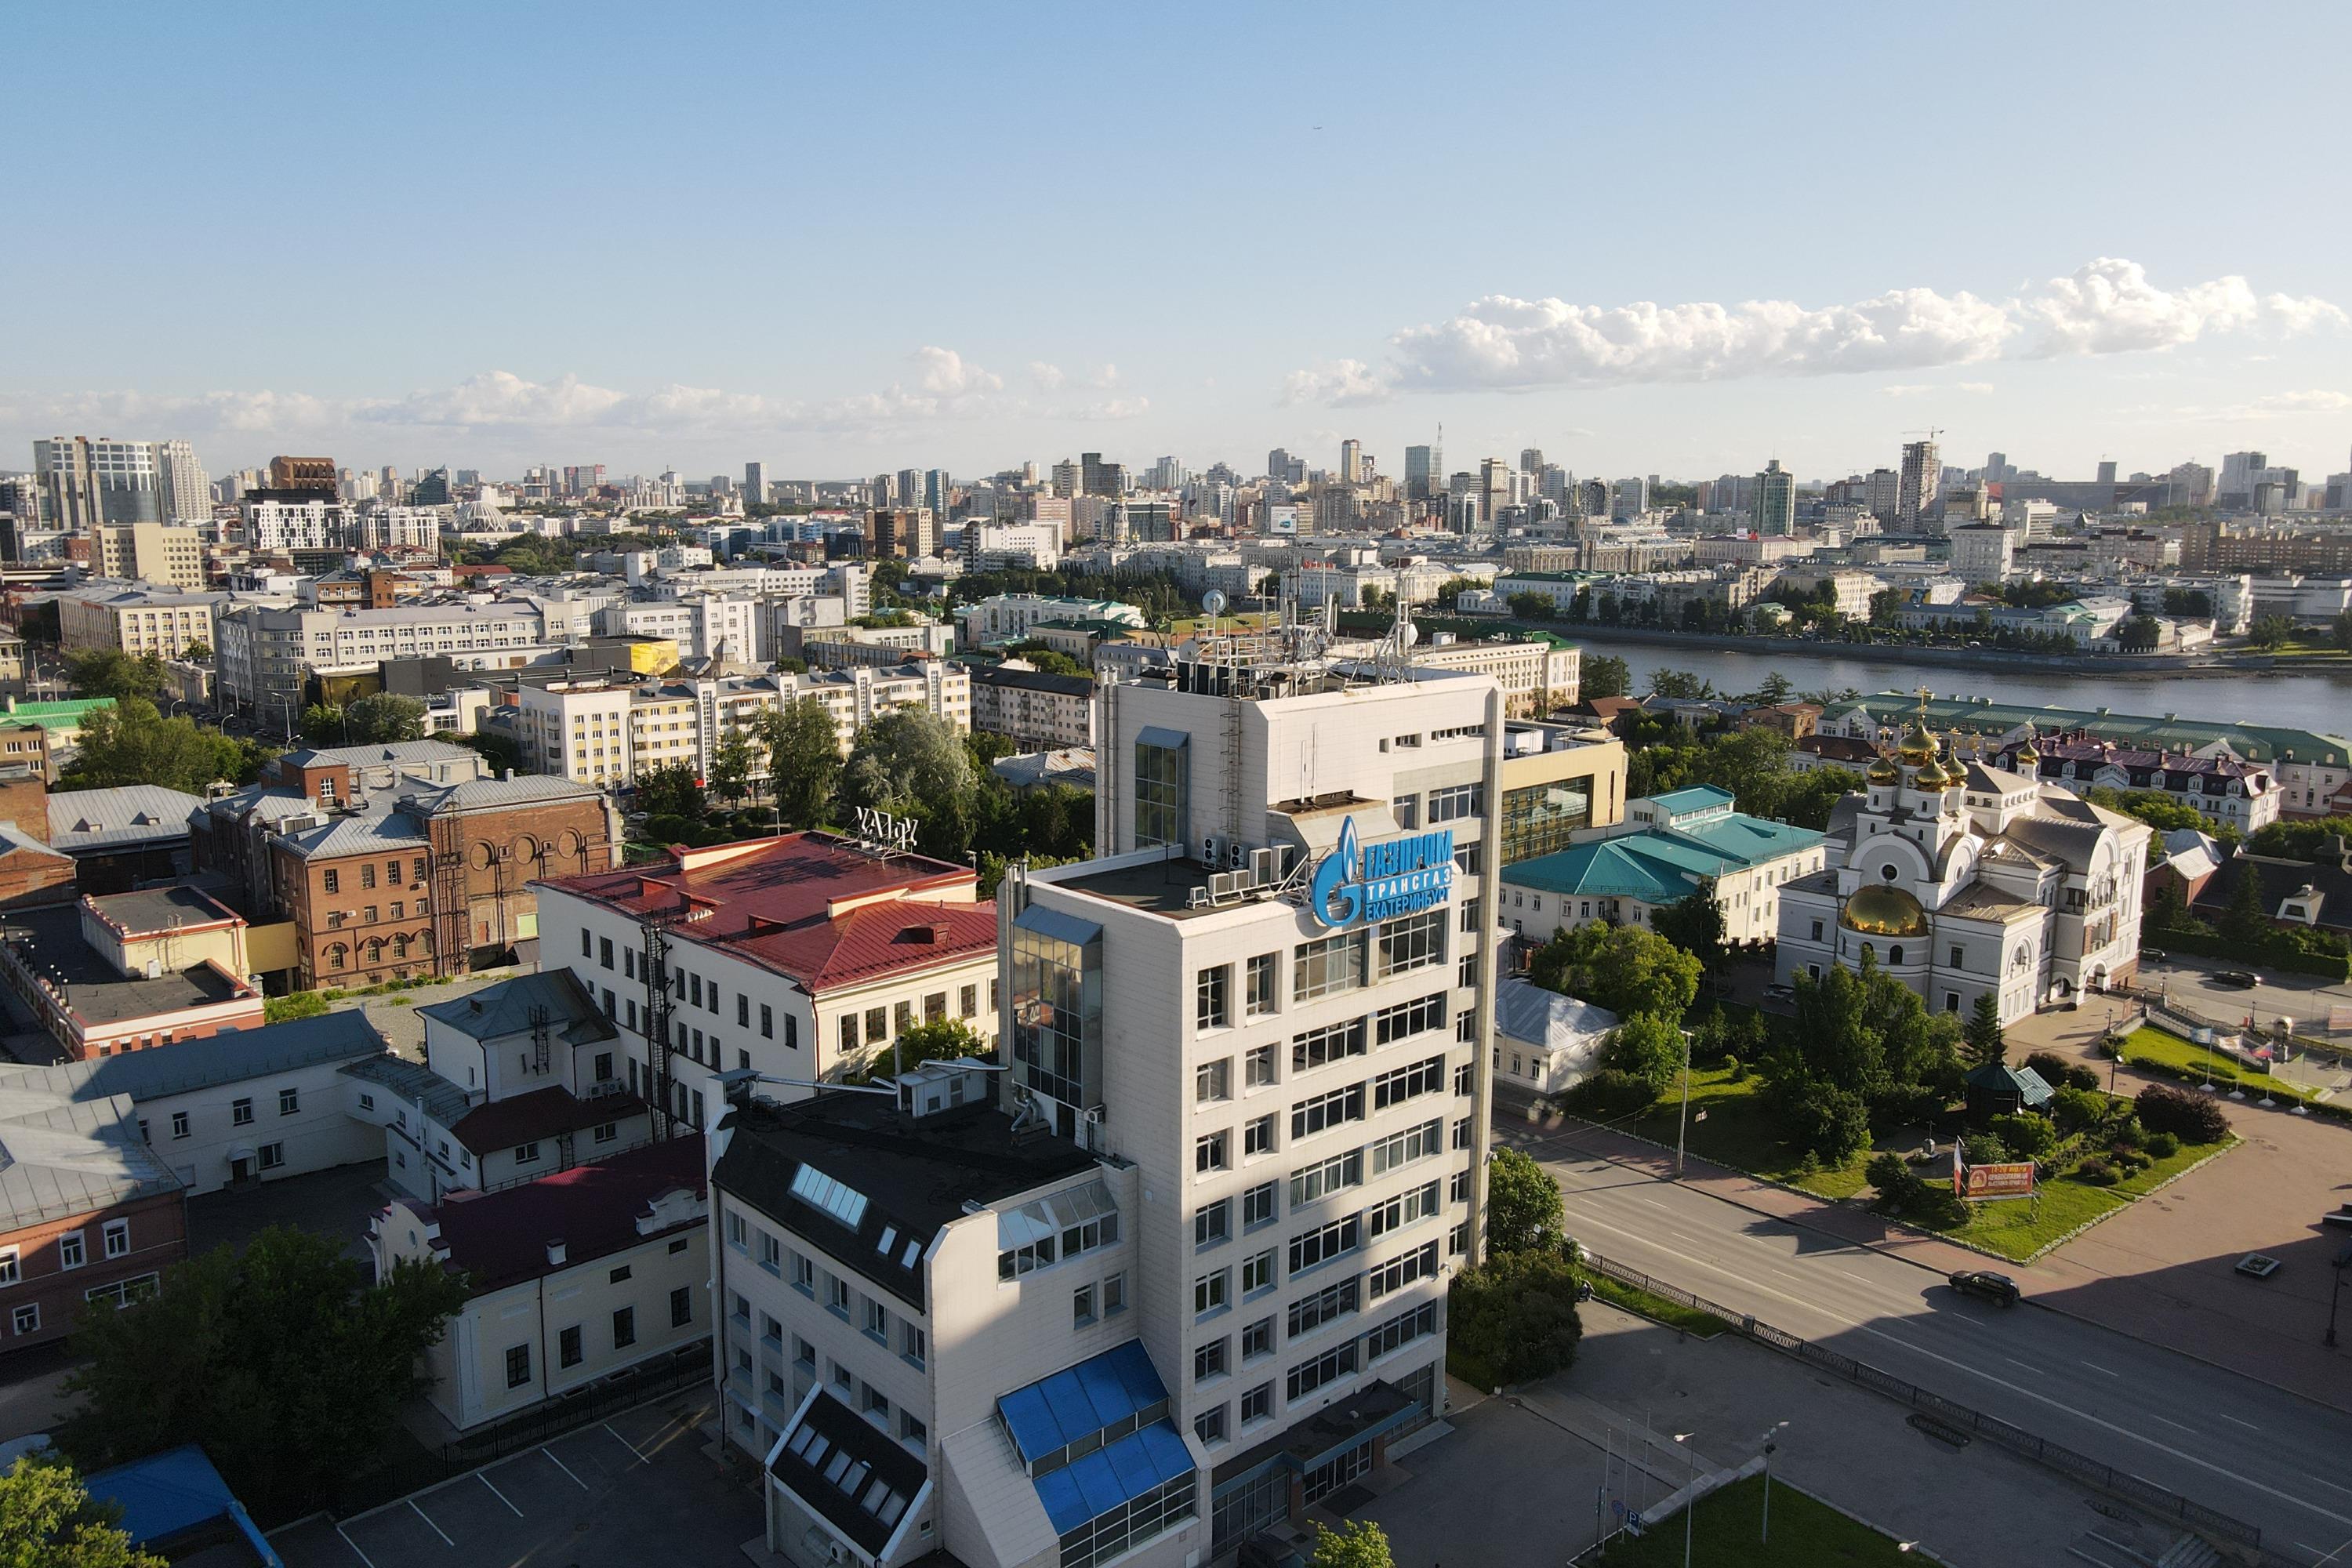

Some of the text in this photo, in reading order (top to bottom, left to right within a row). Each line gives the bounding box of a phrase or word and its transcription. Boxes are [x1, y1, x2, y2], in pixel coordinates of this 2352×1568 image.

[1363, 829, 1453, 880] ГАЗПРОМ
[1367, 868, 1451, 900] ТРАНСГАЗ
[1365, 887, 1451, 922] ЕКАТЕРИНБУРГ
[1630, 1512, 1636, 1523] P
